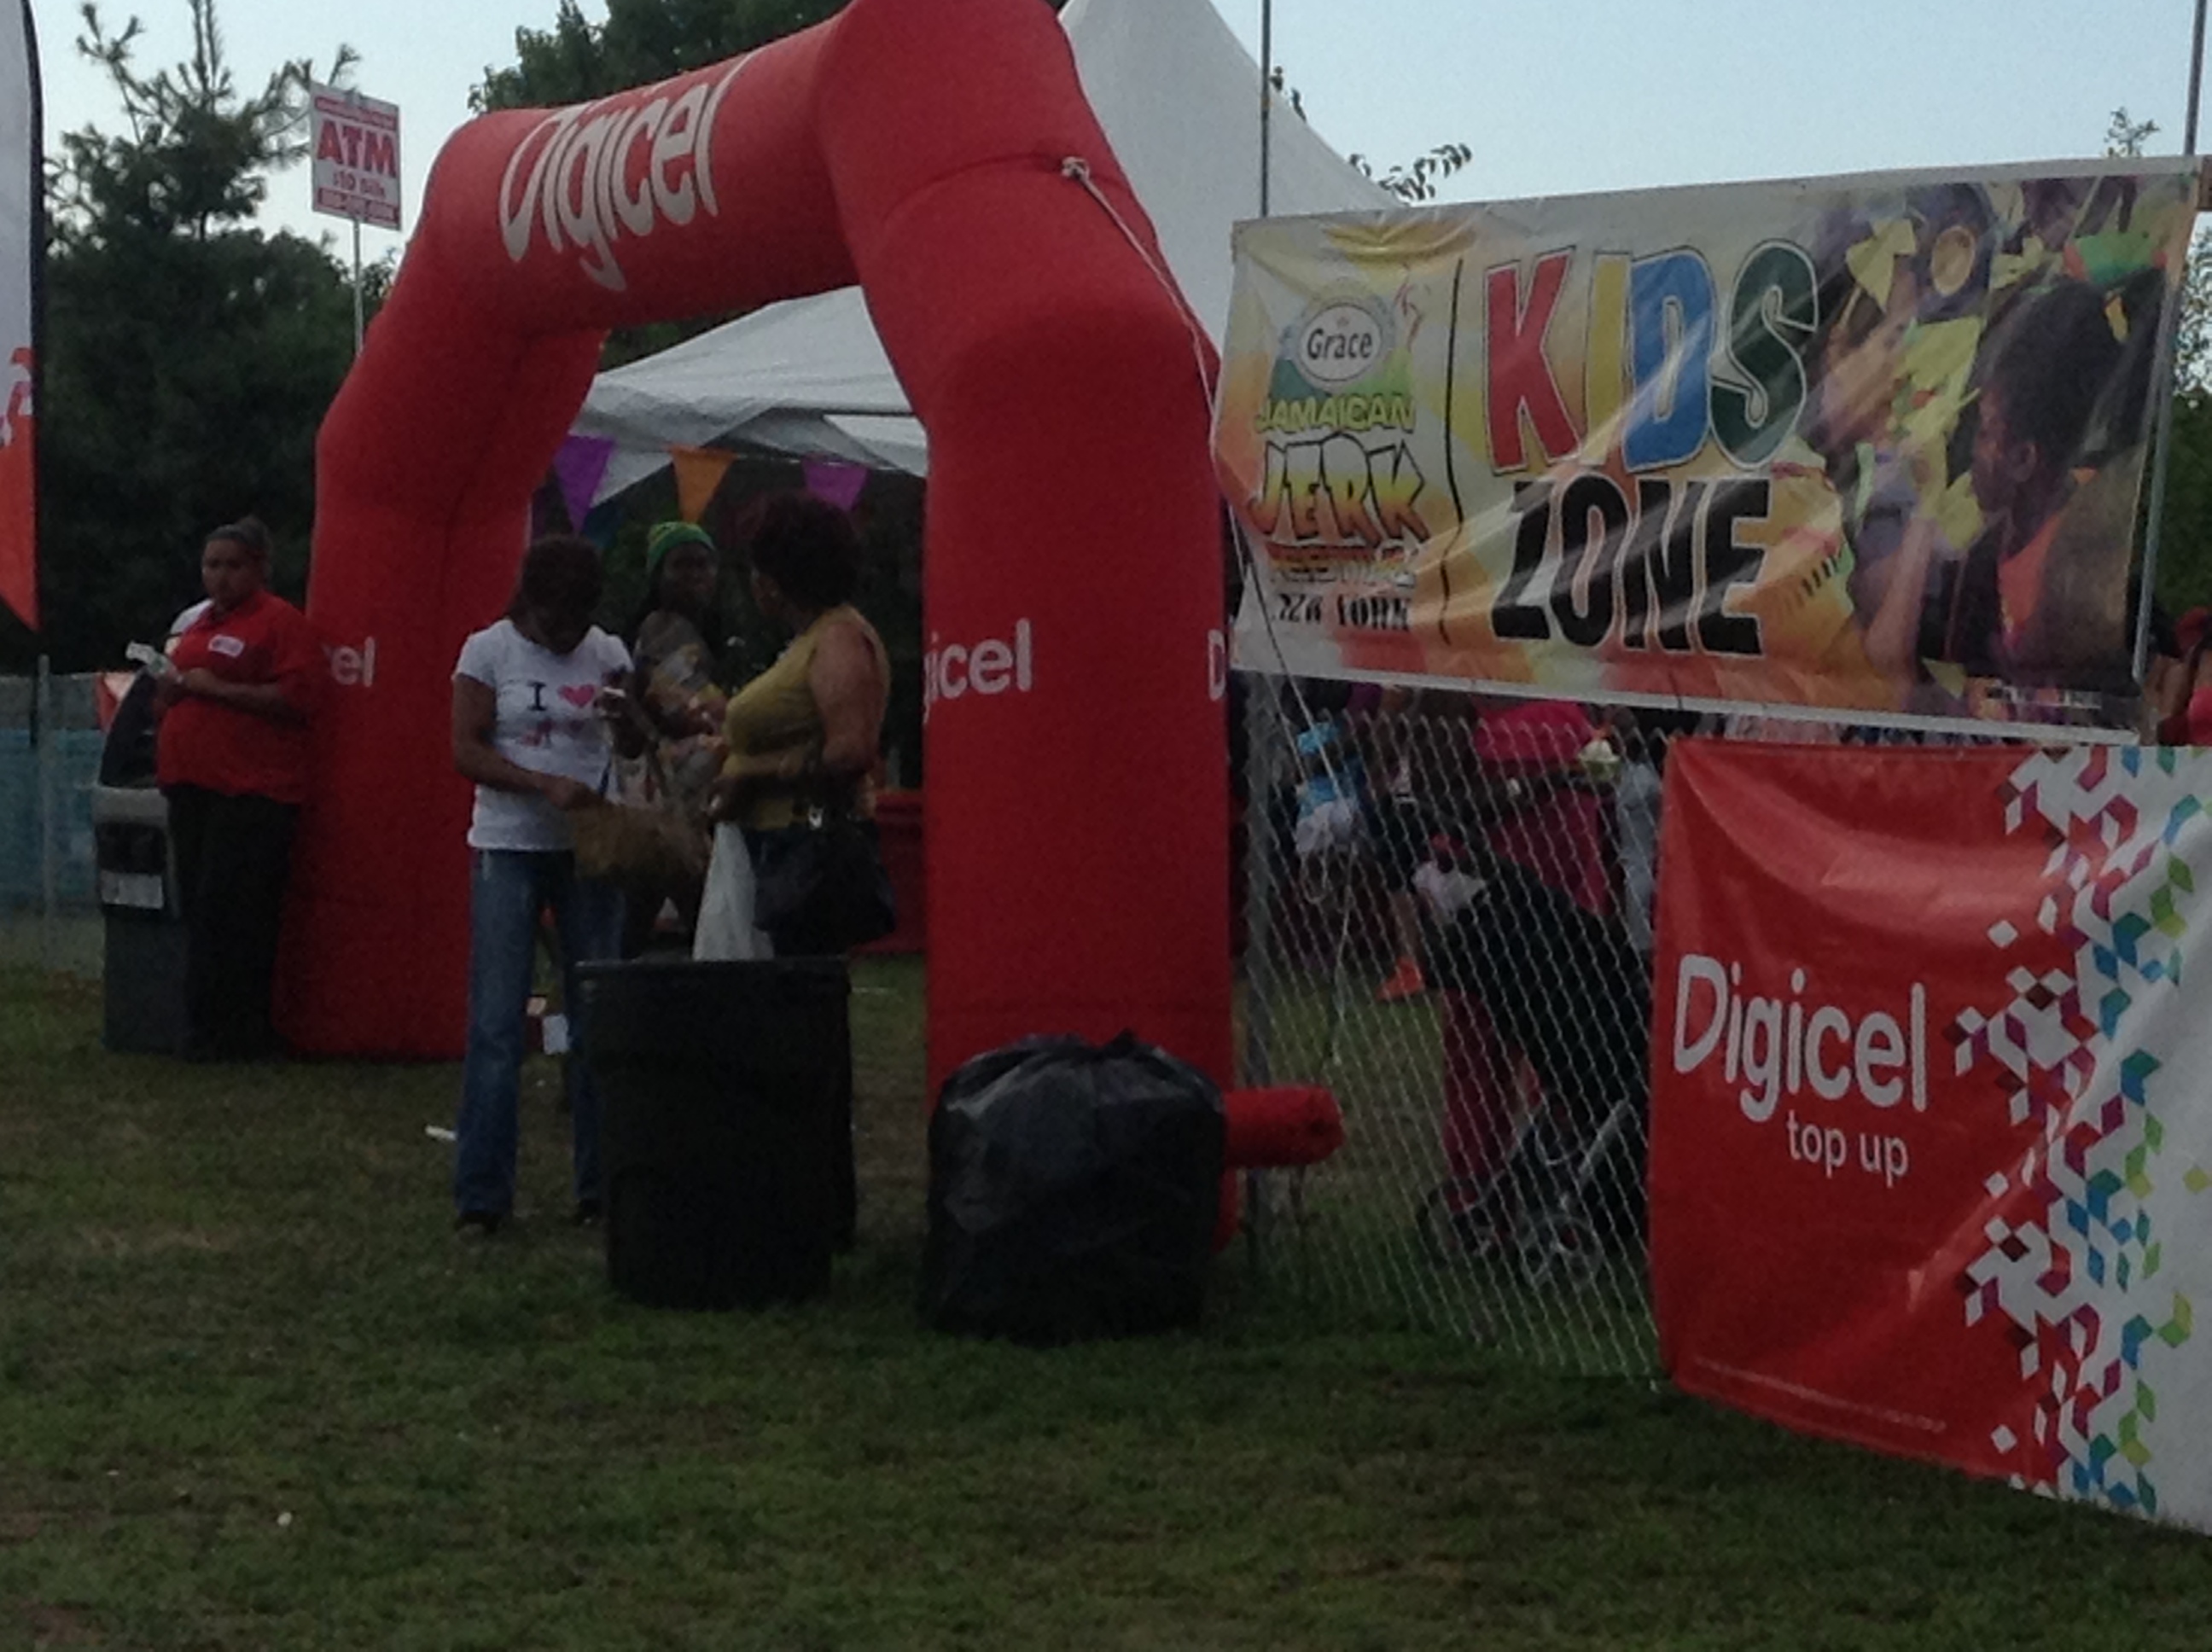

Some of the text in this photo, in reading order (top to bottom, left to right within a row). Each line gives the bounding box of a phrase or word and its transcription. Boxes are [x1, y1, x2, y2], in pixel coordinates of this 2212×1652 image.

[317, 117, 398, 178] ATM
[499, 39, 771, 292] Digicel
[1307, 327, 1373, 360] Grace
[1483, 241, 1819, 476] KIDS
[1255, 390, 1415, 433] JAMAICAN
[1248, 432, 1431, 547] JERK
[1490, 473, 1773, 656] ZONE
[527, 681, 548, 712] I
[1673, 952, 1927, 1123] Digicel
[1786, 1110, 1909, 1188] top up
